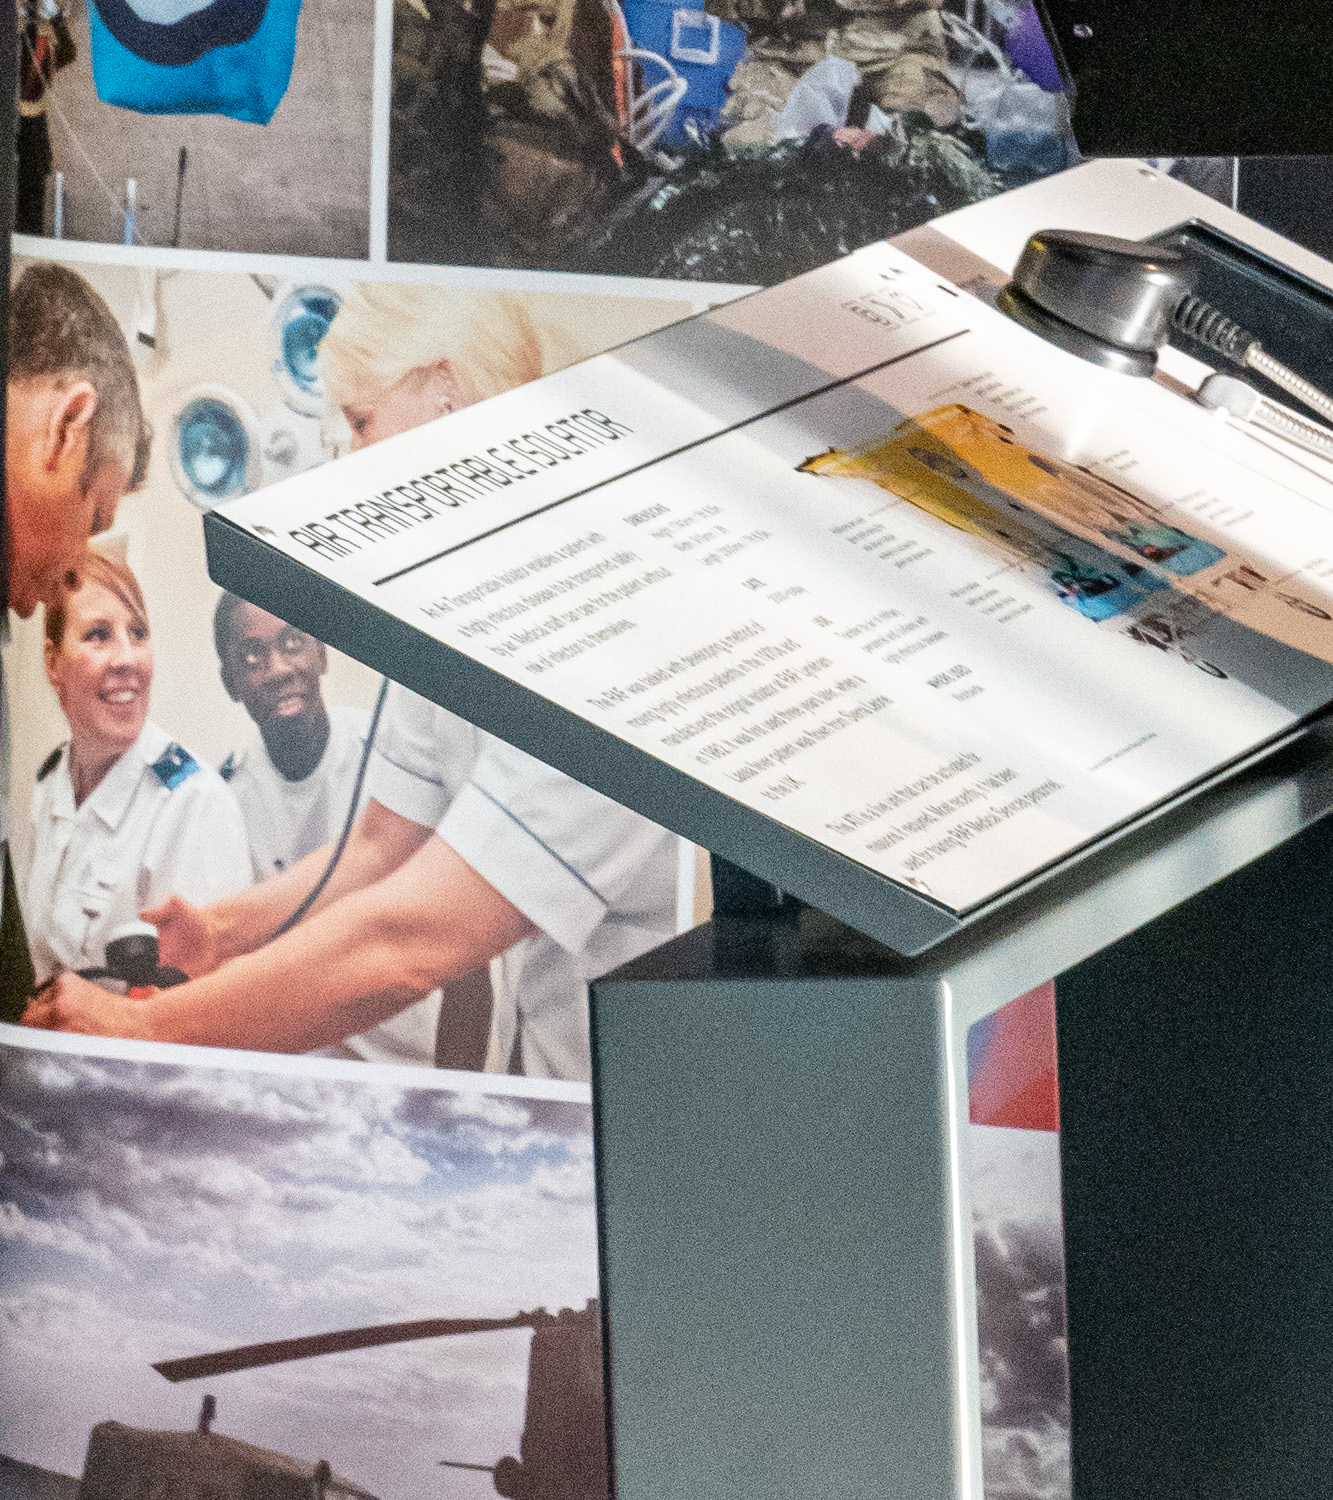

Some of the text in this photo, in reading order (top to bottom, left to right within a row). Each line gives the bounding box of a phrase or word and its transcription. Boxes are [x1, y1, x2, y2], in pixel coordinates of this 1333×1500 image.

[289, 408, 635, 562] AIR TRANSPORTABLE ISOLATOR
